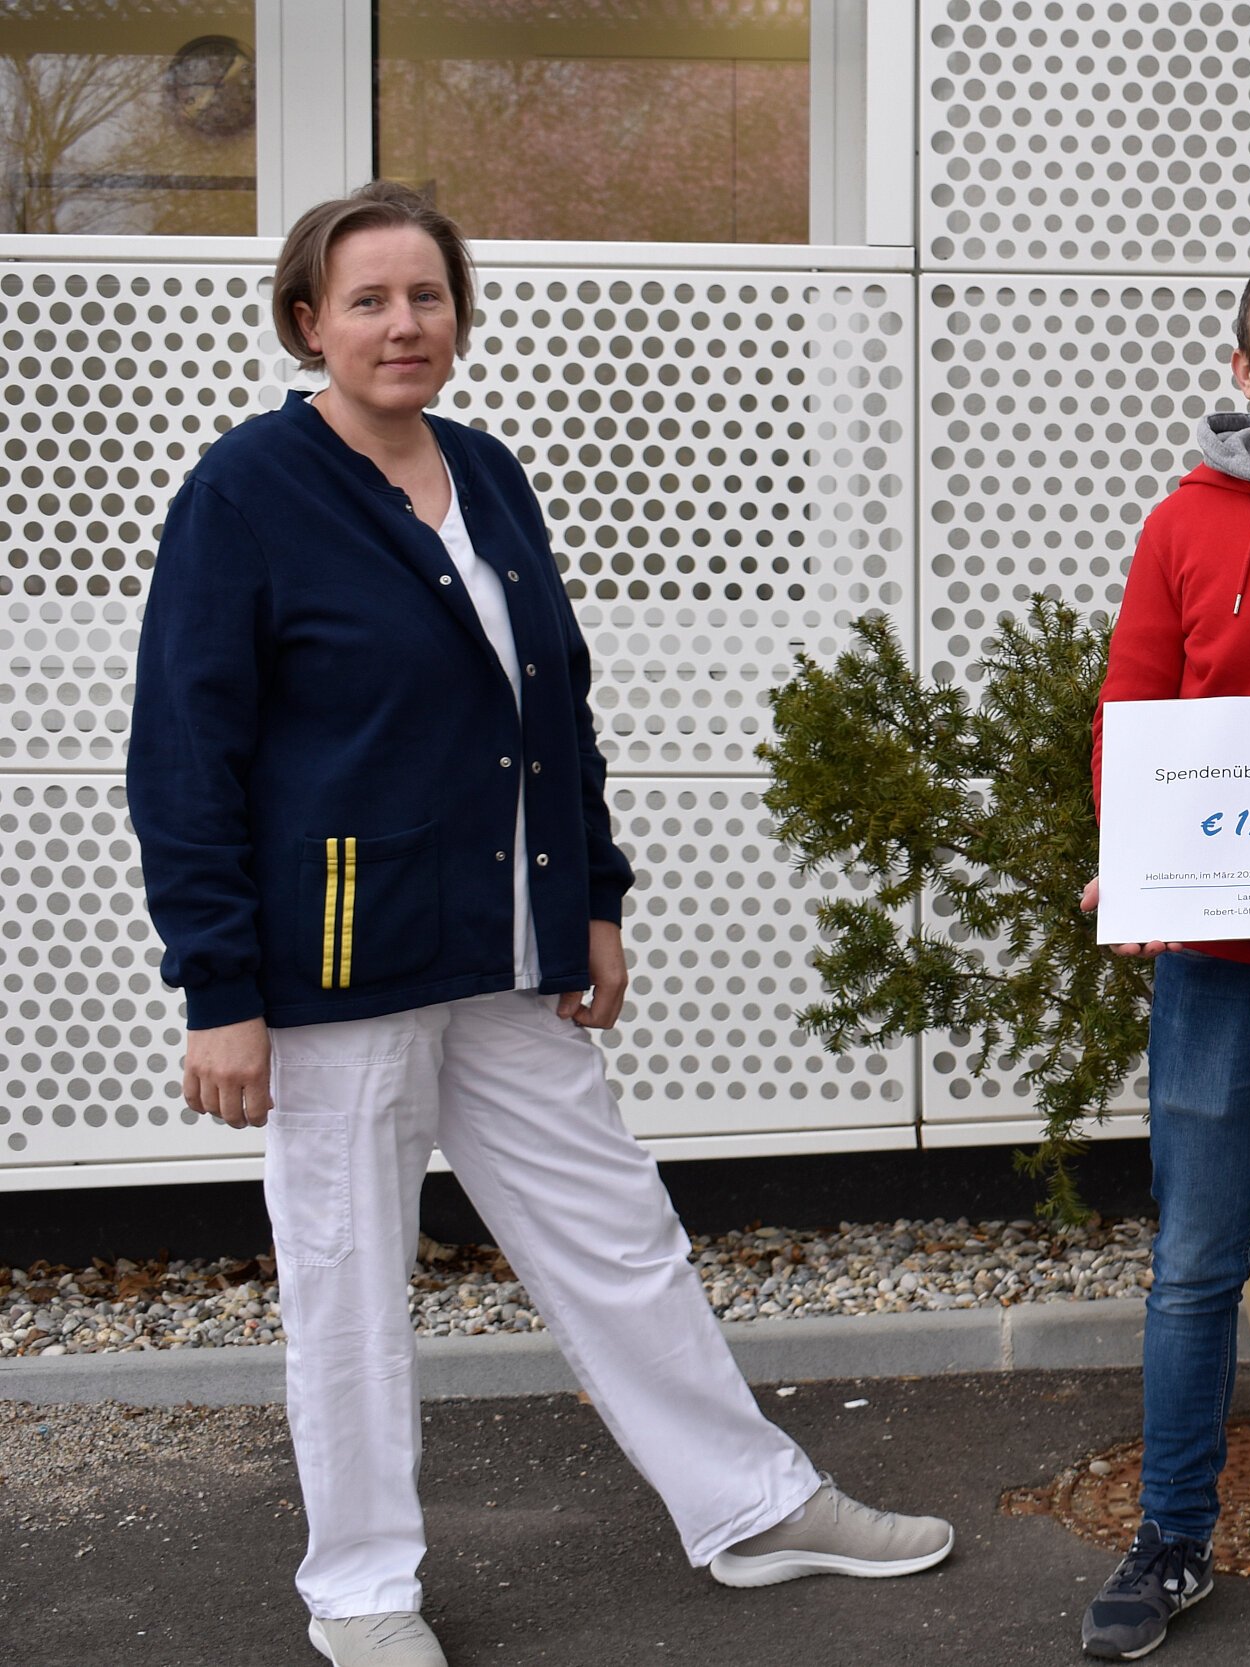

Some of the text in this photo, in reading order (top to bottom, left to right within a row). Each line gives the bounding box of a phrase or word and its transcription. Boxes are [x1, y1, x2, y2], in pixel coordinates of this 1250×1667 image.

[1200, 811, 1224, 837] €
[1145, 872, 1198, 881] Hollabrunn,
[1199, 871, 1212, 880] im
[1213, 871, 1235, 880] März
